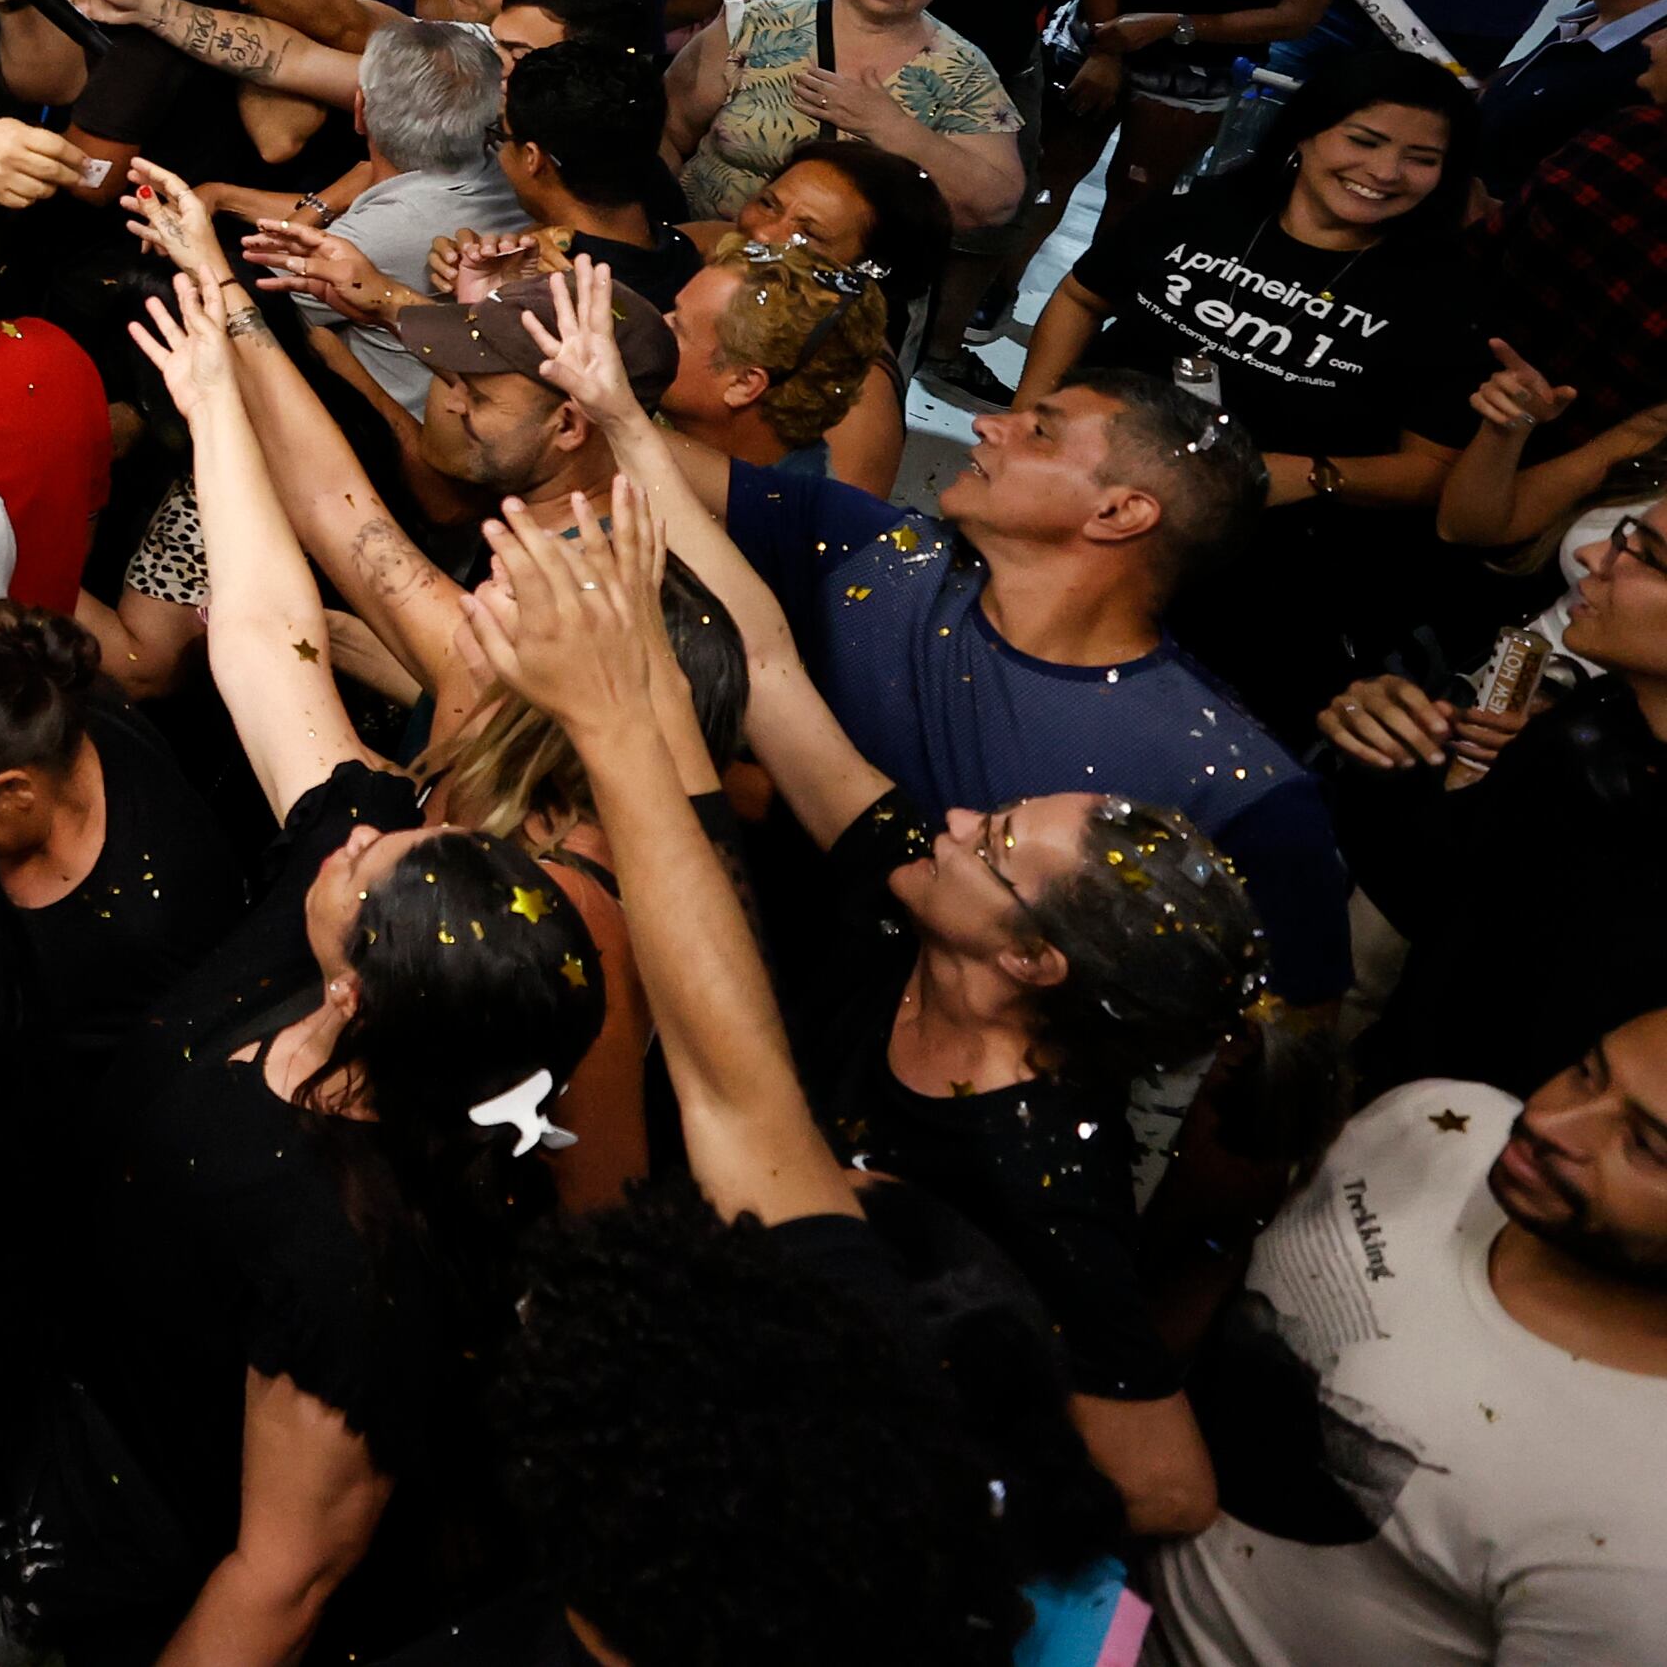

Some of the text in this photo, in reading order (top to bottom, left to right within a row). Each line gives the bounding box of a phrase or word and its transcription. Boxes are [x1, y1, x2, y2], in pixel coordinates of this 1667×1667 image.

[1164, 243, 1389, 339] A primeira TV
[1165, 274, 1364, 375] 3 em 1 com
[1342, 1179, 1394, 1284] Trekking
